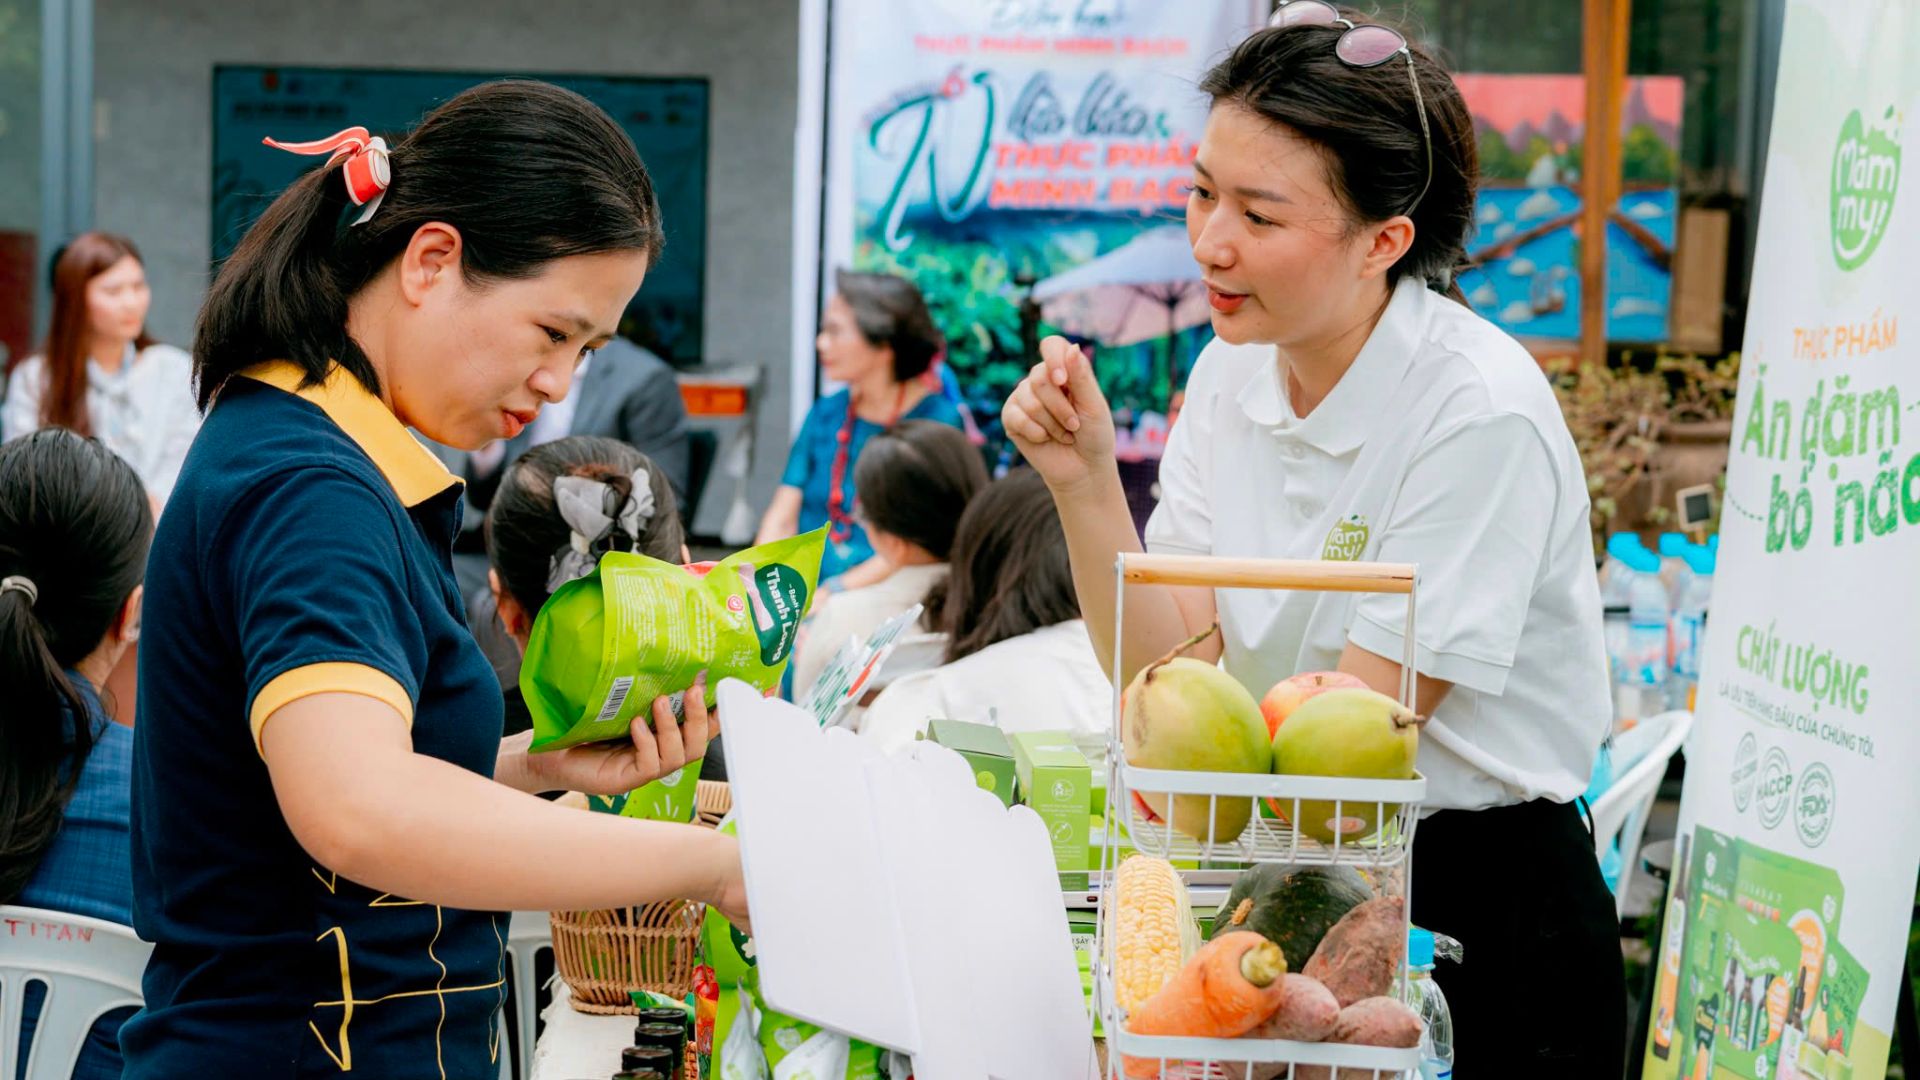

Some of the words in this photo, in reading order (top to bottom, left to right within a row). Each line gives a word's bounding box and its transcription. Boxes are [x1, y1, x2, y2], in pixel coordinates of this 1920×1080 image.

[995, 139, 1096, 170] THỰC
[1105, 132, 1200, 168] PHẨ
[989, 176, 1096, 208] MINH
[1108, 176, 1193, 214] BẠC
[766, 567, 792, 621] Thanh
[1782, 643, 1869, 715] LƯỢNG
[4, 918, 95, 942] TITAN
